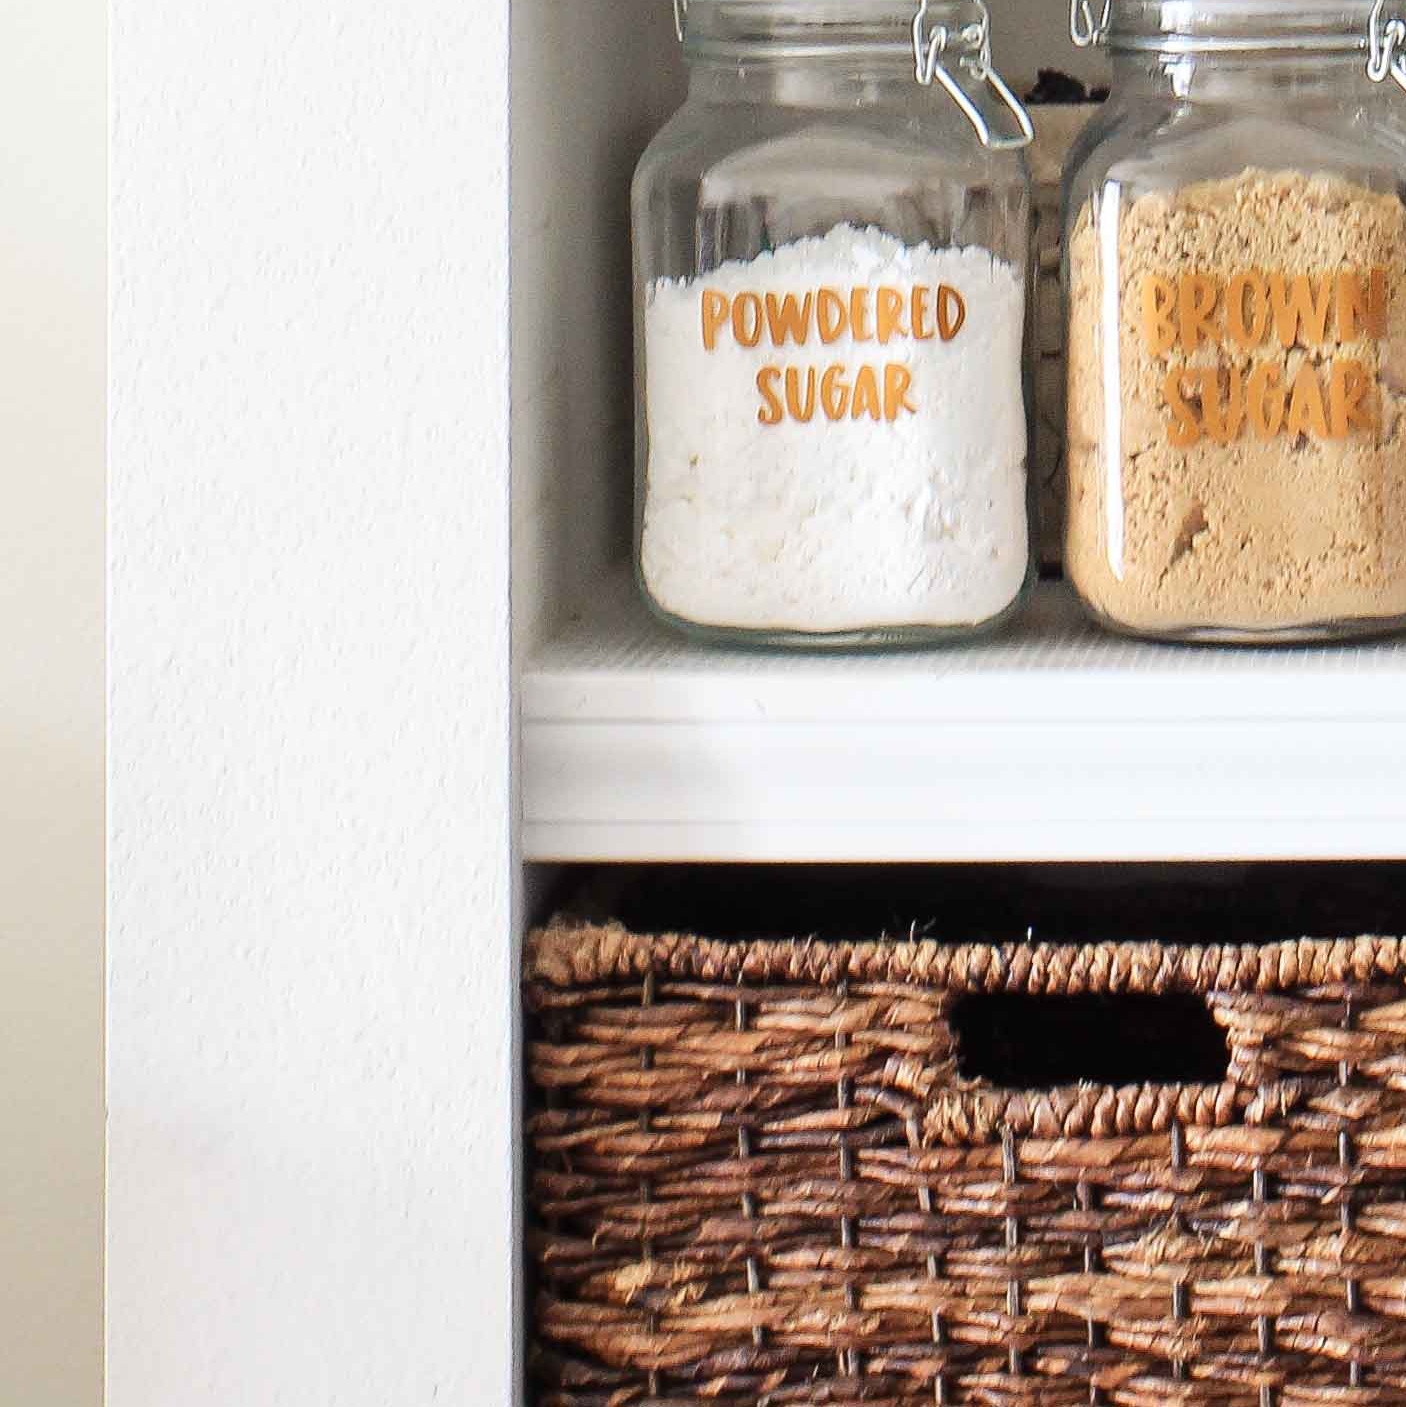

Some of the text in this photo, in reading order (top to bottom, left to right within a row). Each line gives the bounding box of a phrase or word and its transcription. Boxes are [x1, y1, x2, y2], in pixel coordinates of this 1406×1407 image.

[702, 284, 967, 352] POWDERED
[1142, 266, 1388, 356] BROWN
[757, 363, 917, 425] SUGAR
[1164, 360, 1382, 448] SUGAR
